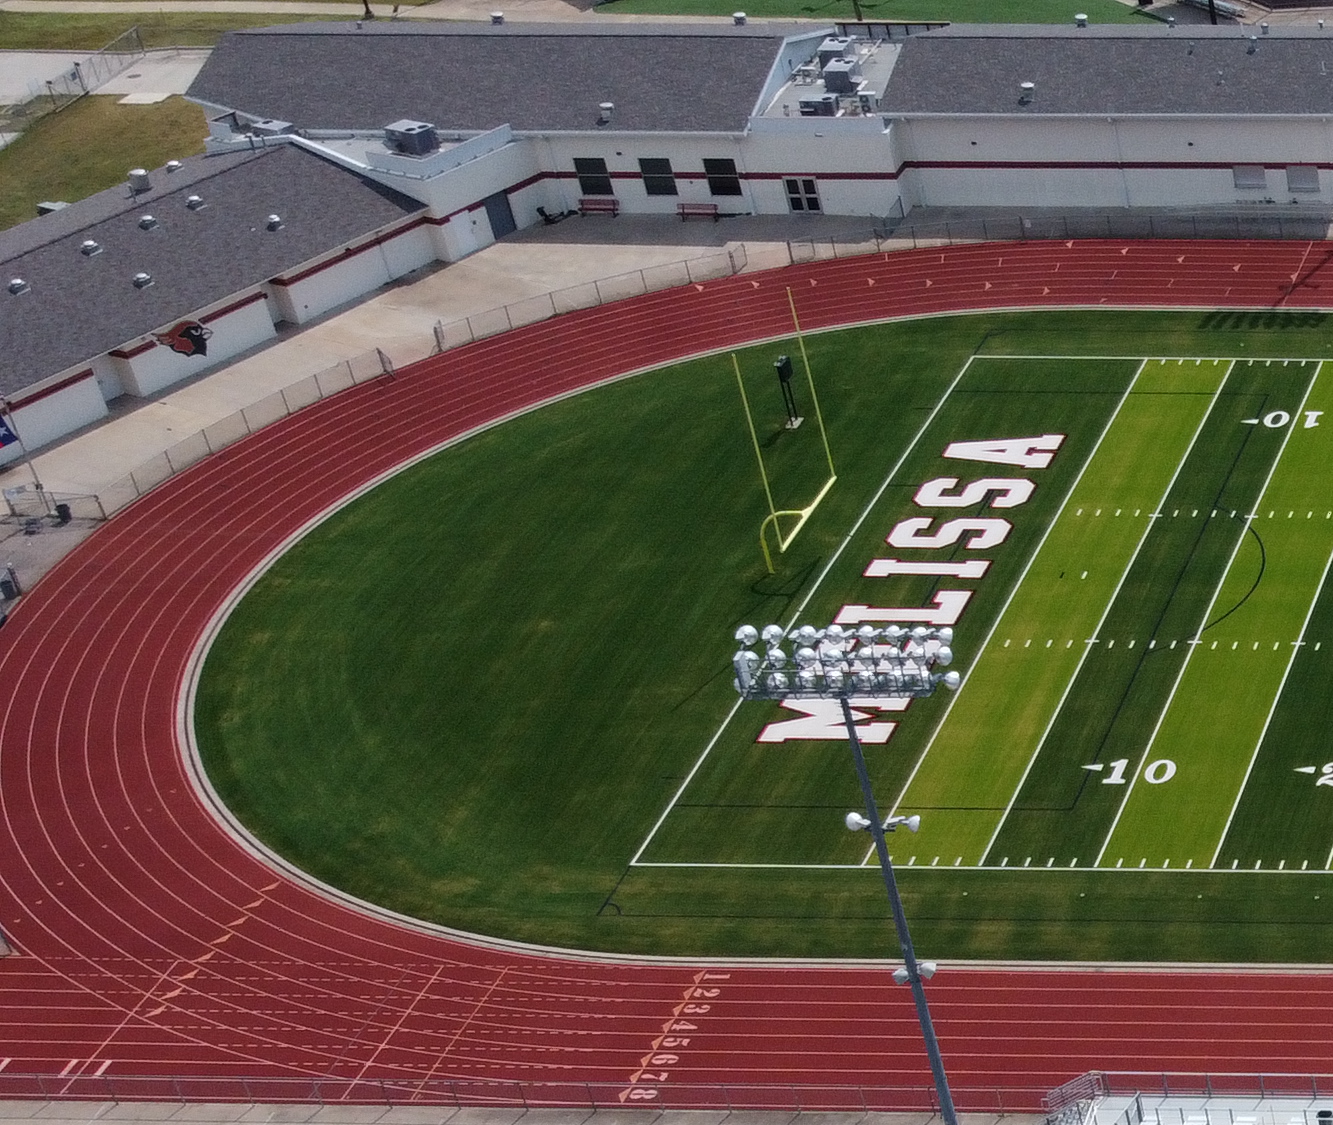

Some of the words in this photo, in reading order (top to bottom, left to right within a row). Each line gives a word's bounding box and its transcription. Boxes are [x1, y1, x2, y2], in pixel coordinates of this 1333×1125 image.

[1263, 410, 1324, 428] 10
[1101, 758, 1177, 784] 10
[693, 988, 720, 997] 2
[683, 1004, 711, 1013] 3
[671, 1020, 698, 1030] 4
[662, 1038, 691, 1047] 5
[651, 1054, 679, 1064] 6
[641, 1072, 669, 1081] 7
[629, 1089, 658, 1099] 8
